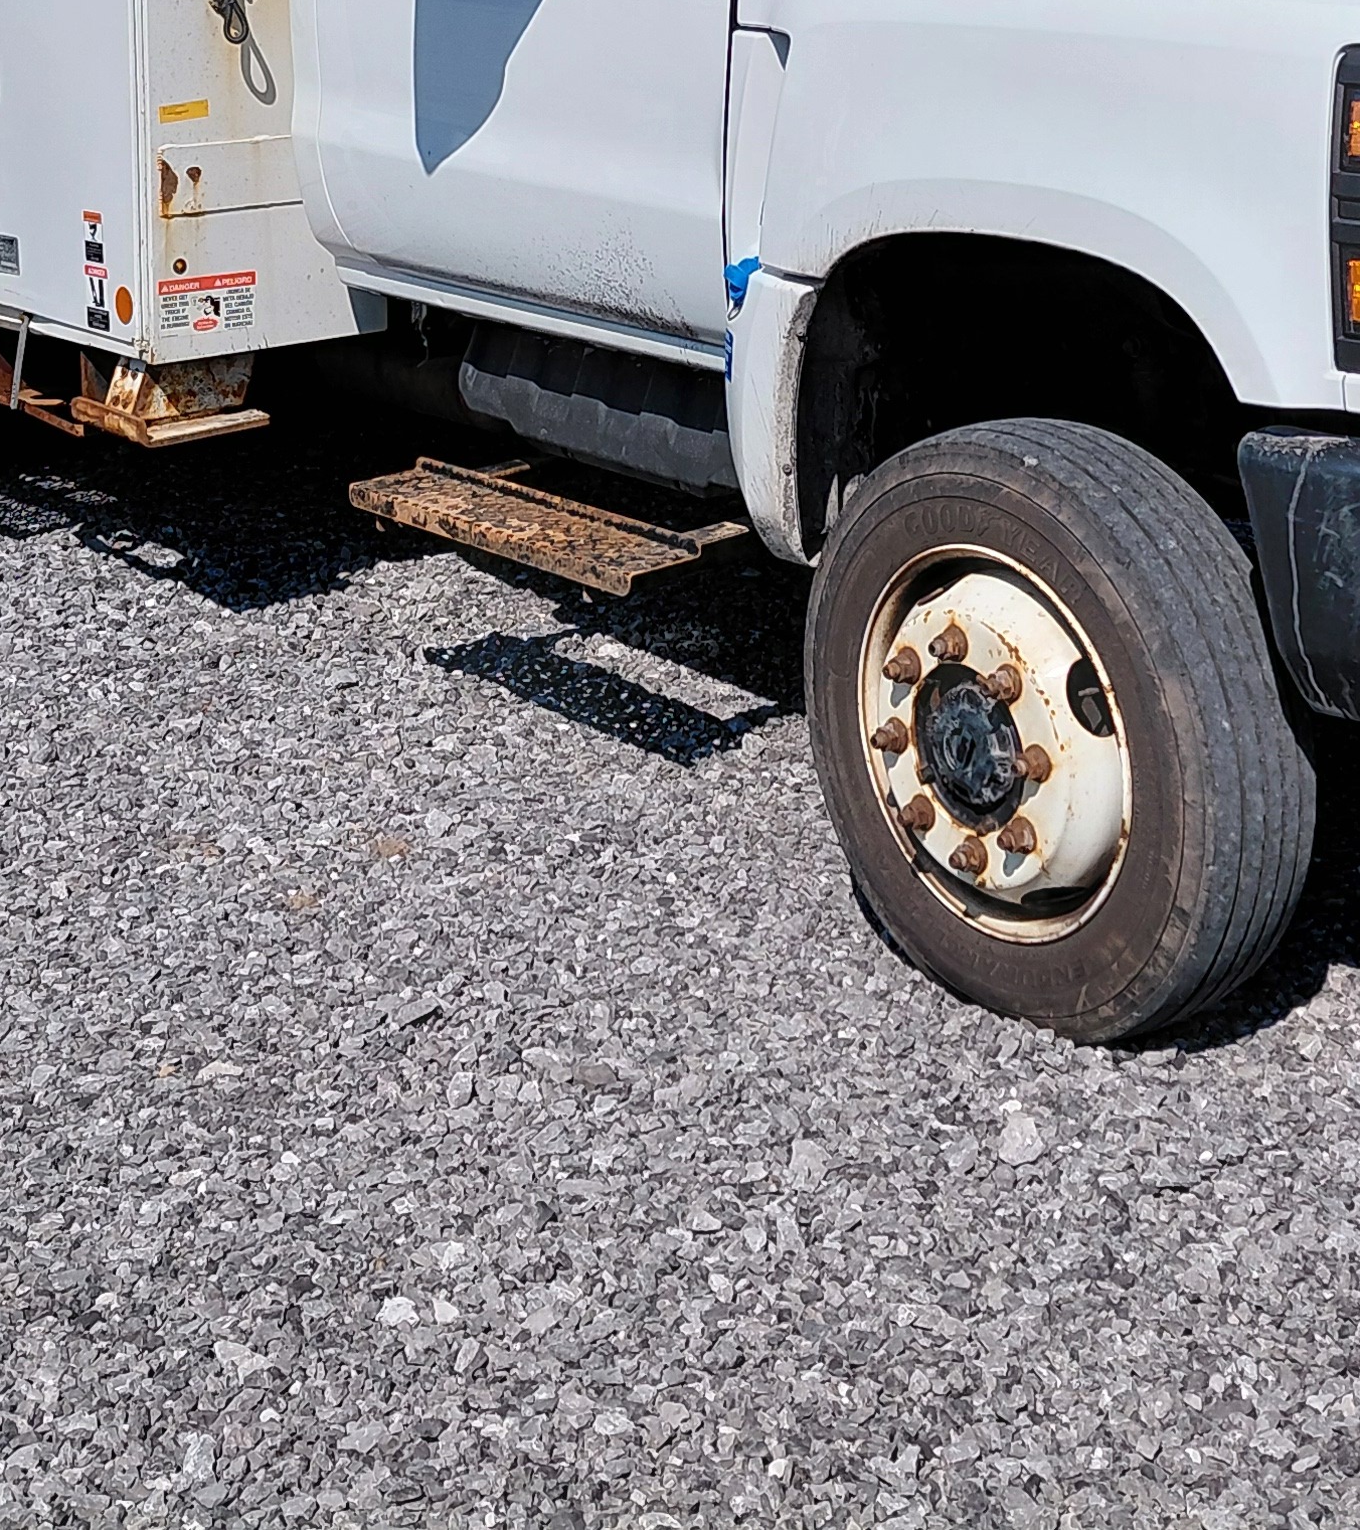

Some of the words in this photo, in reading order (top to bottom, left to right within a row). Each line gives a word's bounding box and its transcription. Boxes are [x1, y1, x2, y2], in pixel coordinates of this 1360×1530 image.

[221, 275, 253, 286] PELIGRO
[168, 281, 200, 293] DANGER
[903, 502, 1086, 606] GOODYEAR
